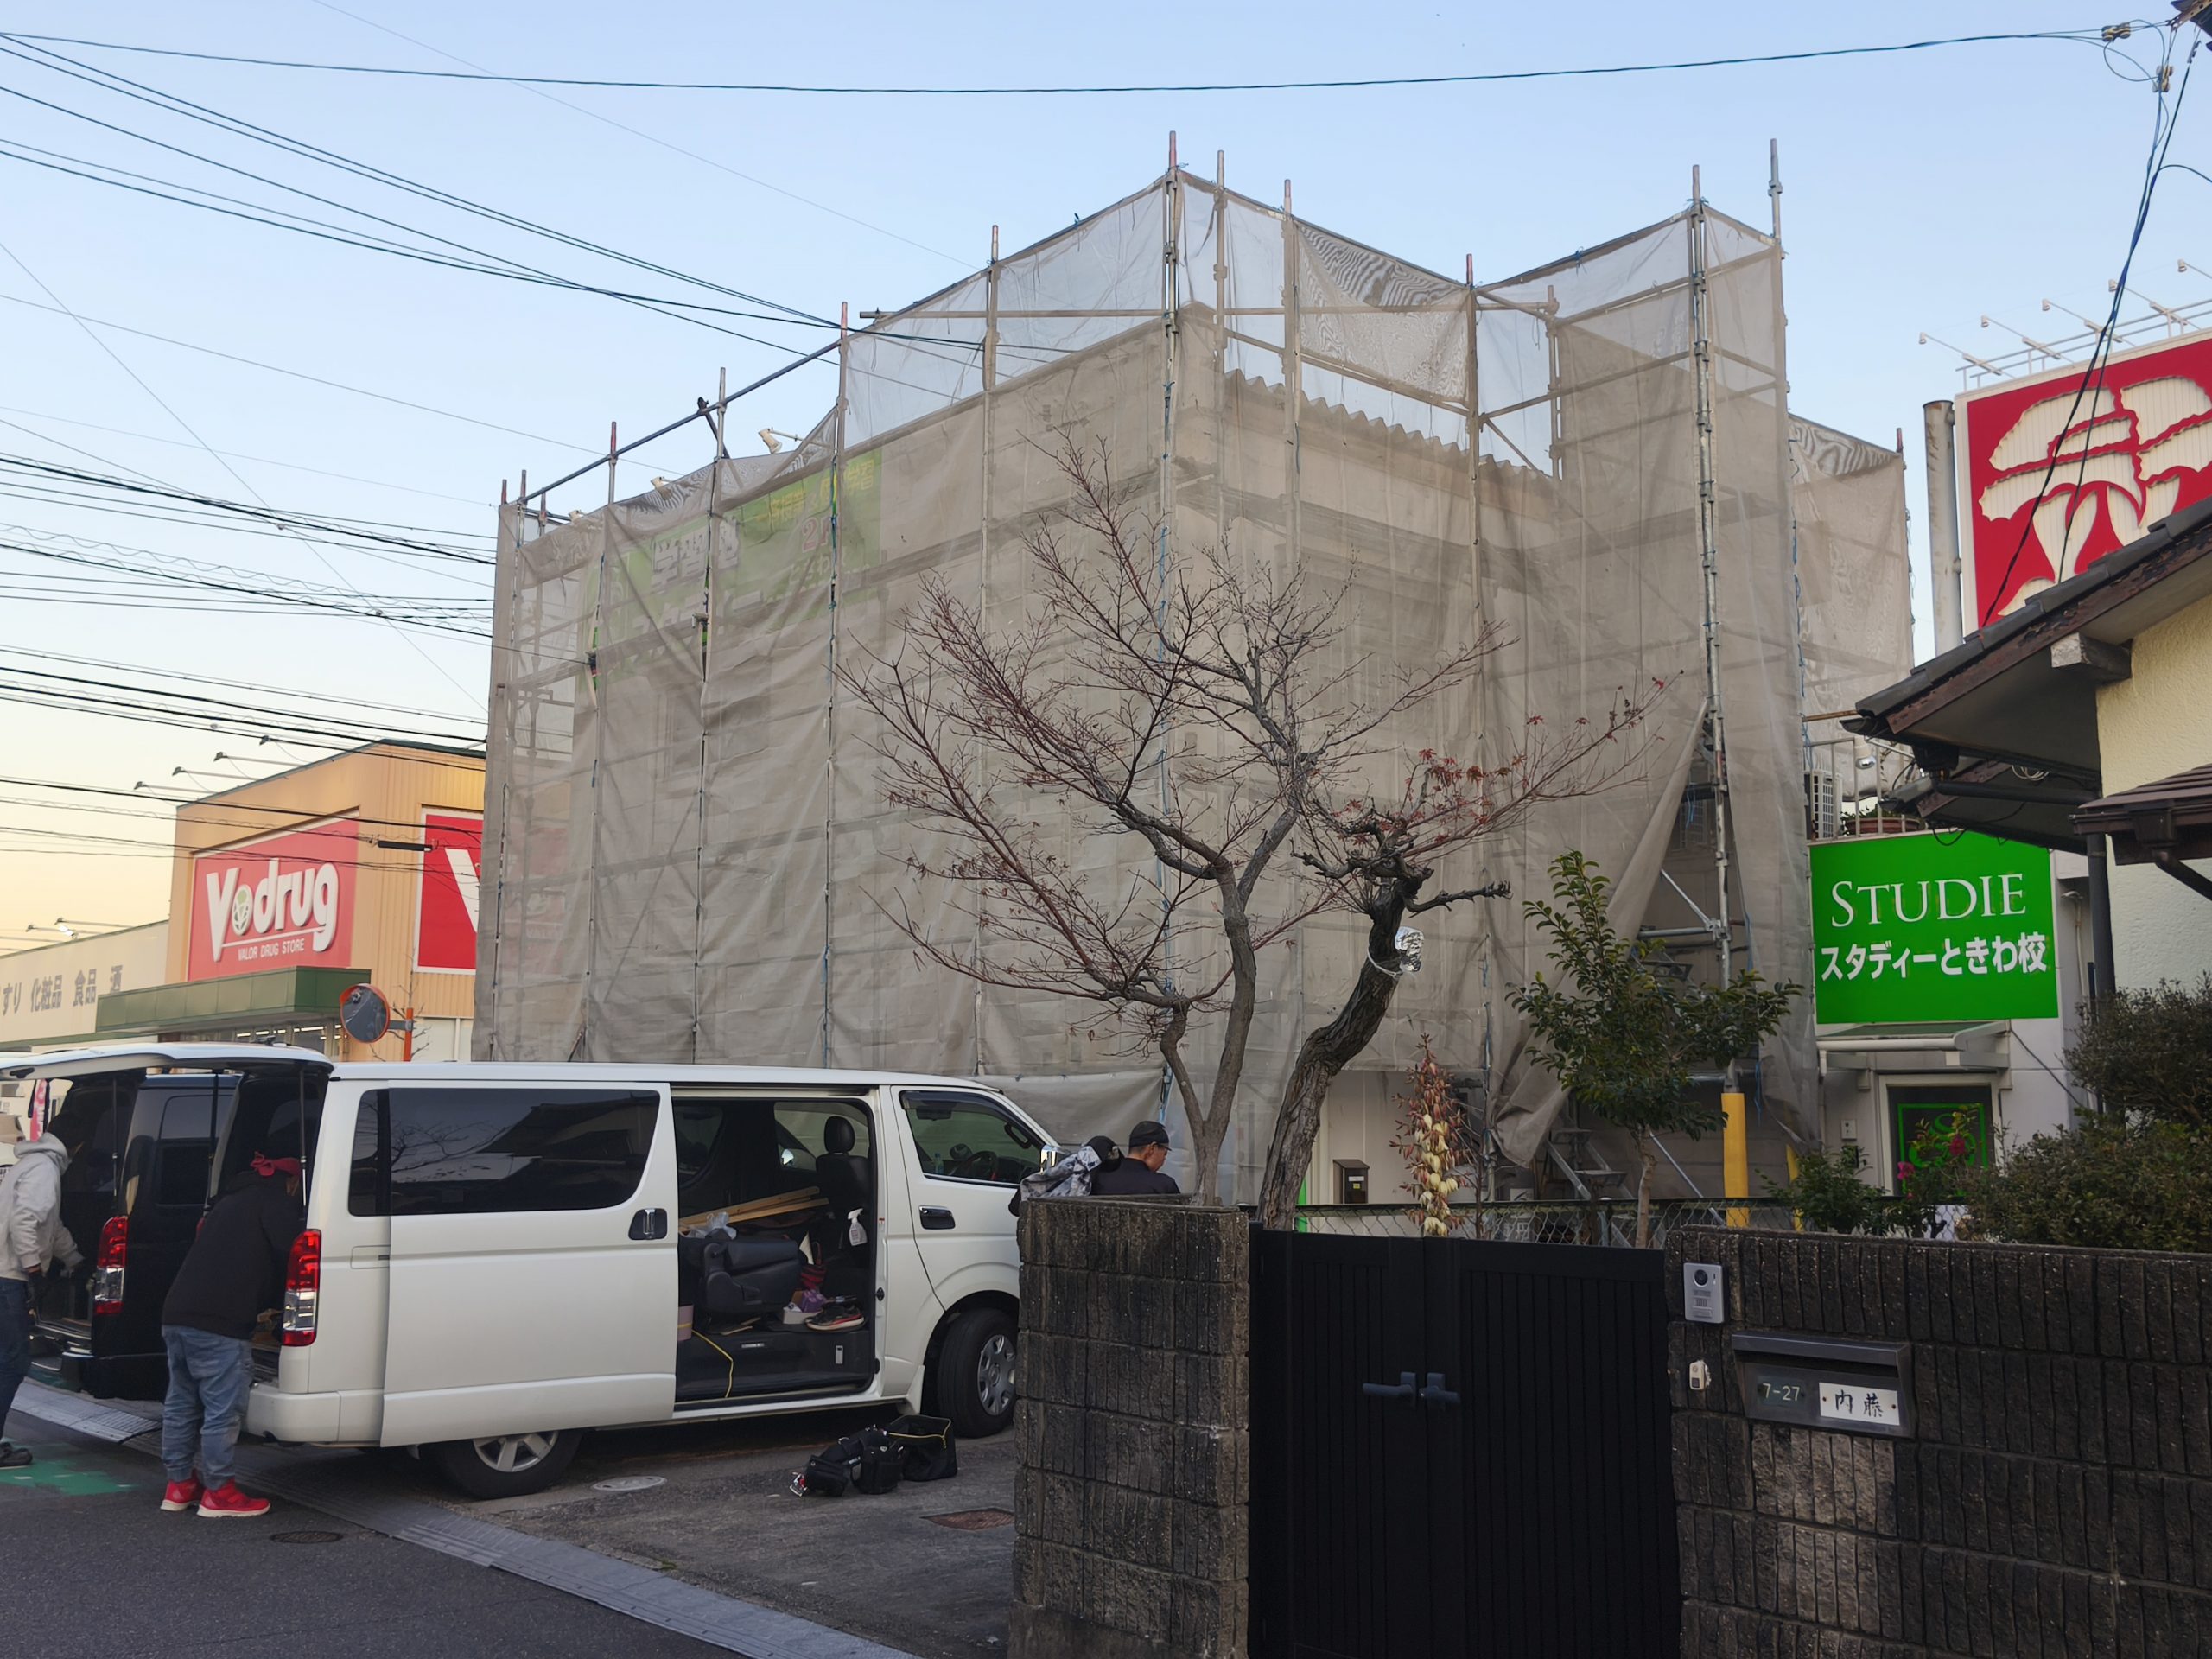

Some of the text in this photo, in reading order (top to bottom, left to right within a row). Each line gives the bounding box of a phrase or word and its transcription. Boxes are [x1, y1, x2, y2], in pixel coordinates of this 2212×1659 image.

[1831, 873, 2026, 927] STUDIE
[238, 938, 305, 962] VALOR DRUG STORE
[1821, 931, 2047, 982] スタディーときわ校
[72, 968, 97, 1007] 食品
[1761, 1382, 1802, 1403] 7-27
